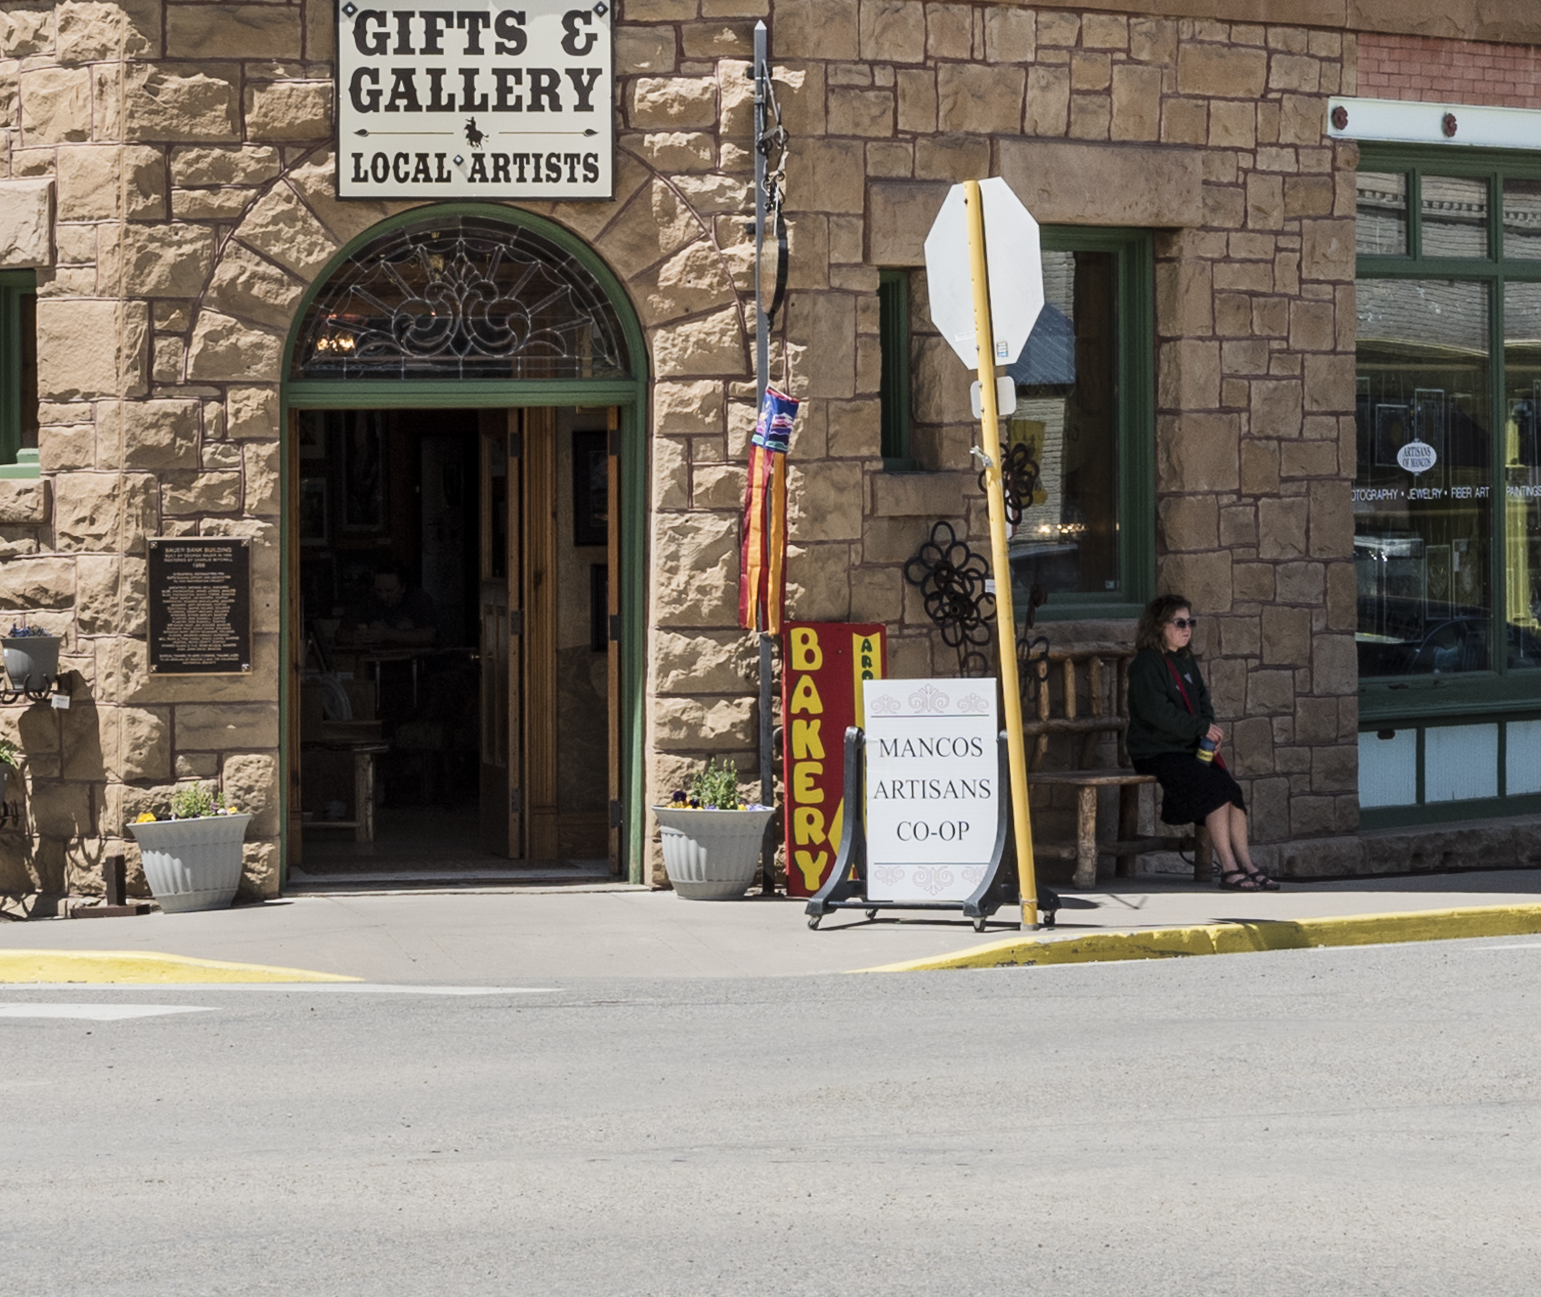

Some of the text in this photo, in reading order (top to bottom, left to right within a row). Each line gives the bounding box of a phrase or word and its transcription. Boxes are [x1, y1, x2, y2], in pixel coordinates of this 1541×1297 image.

[352, 9, 598, 56] GIFTS &
[348, 66, 603, 114] GALLERY
[350, 152, 600, 184] LOCAL ARTISTS
[1403, 447, 1431, 457] ARTISANS
[1407, 488, 1443, 500] JEWELRY
[1451, 487, 1473, 499] FIBER
[1474, 486, 1490, 499] ART
[879, 736, 983, 758] MANCOS
[789, 627, 828, 891] BAKERY
[873, 779, 992, 800] ARTISANS
[896, 820, 970, 842] CO-OP
